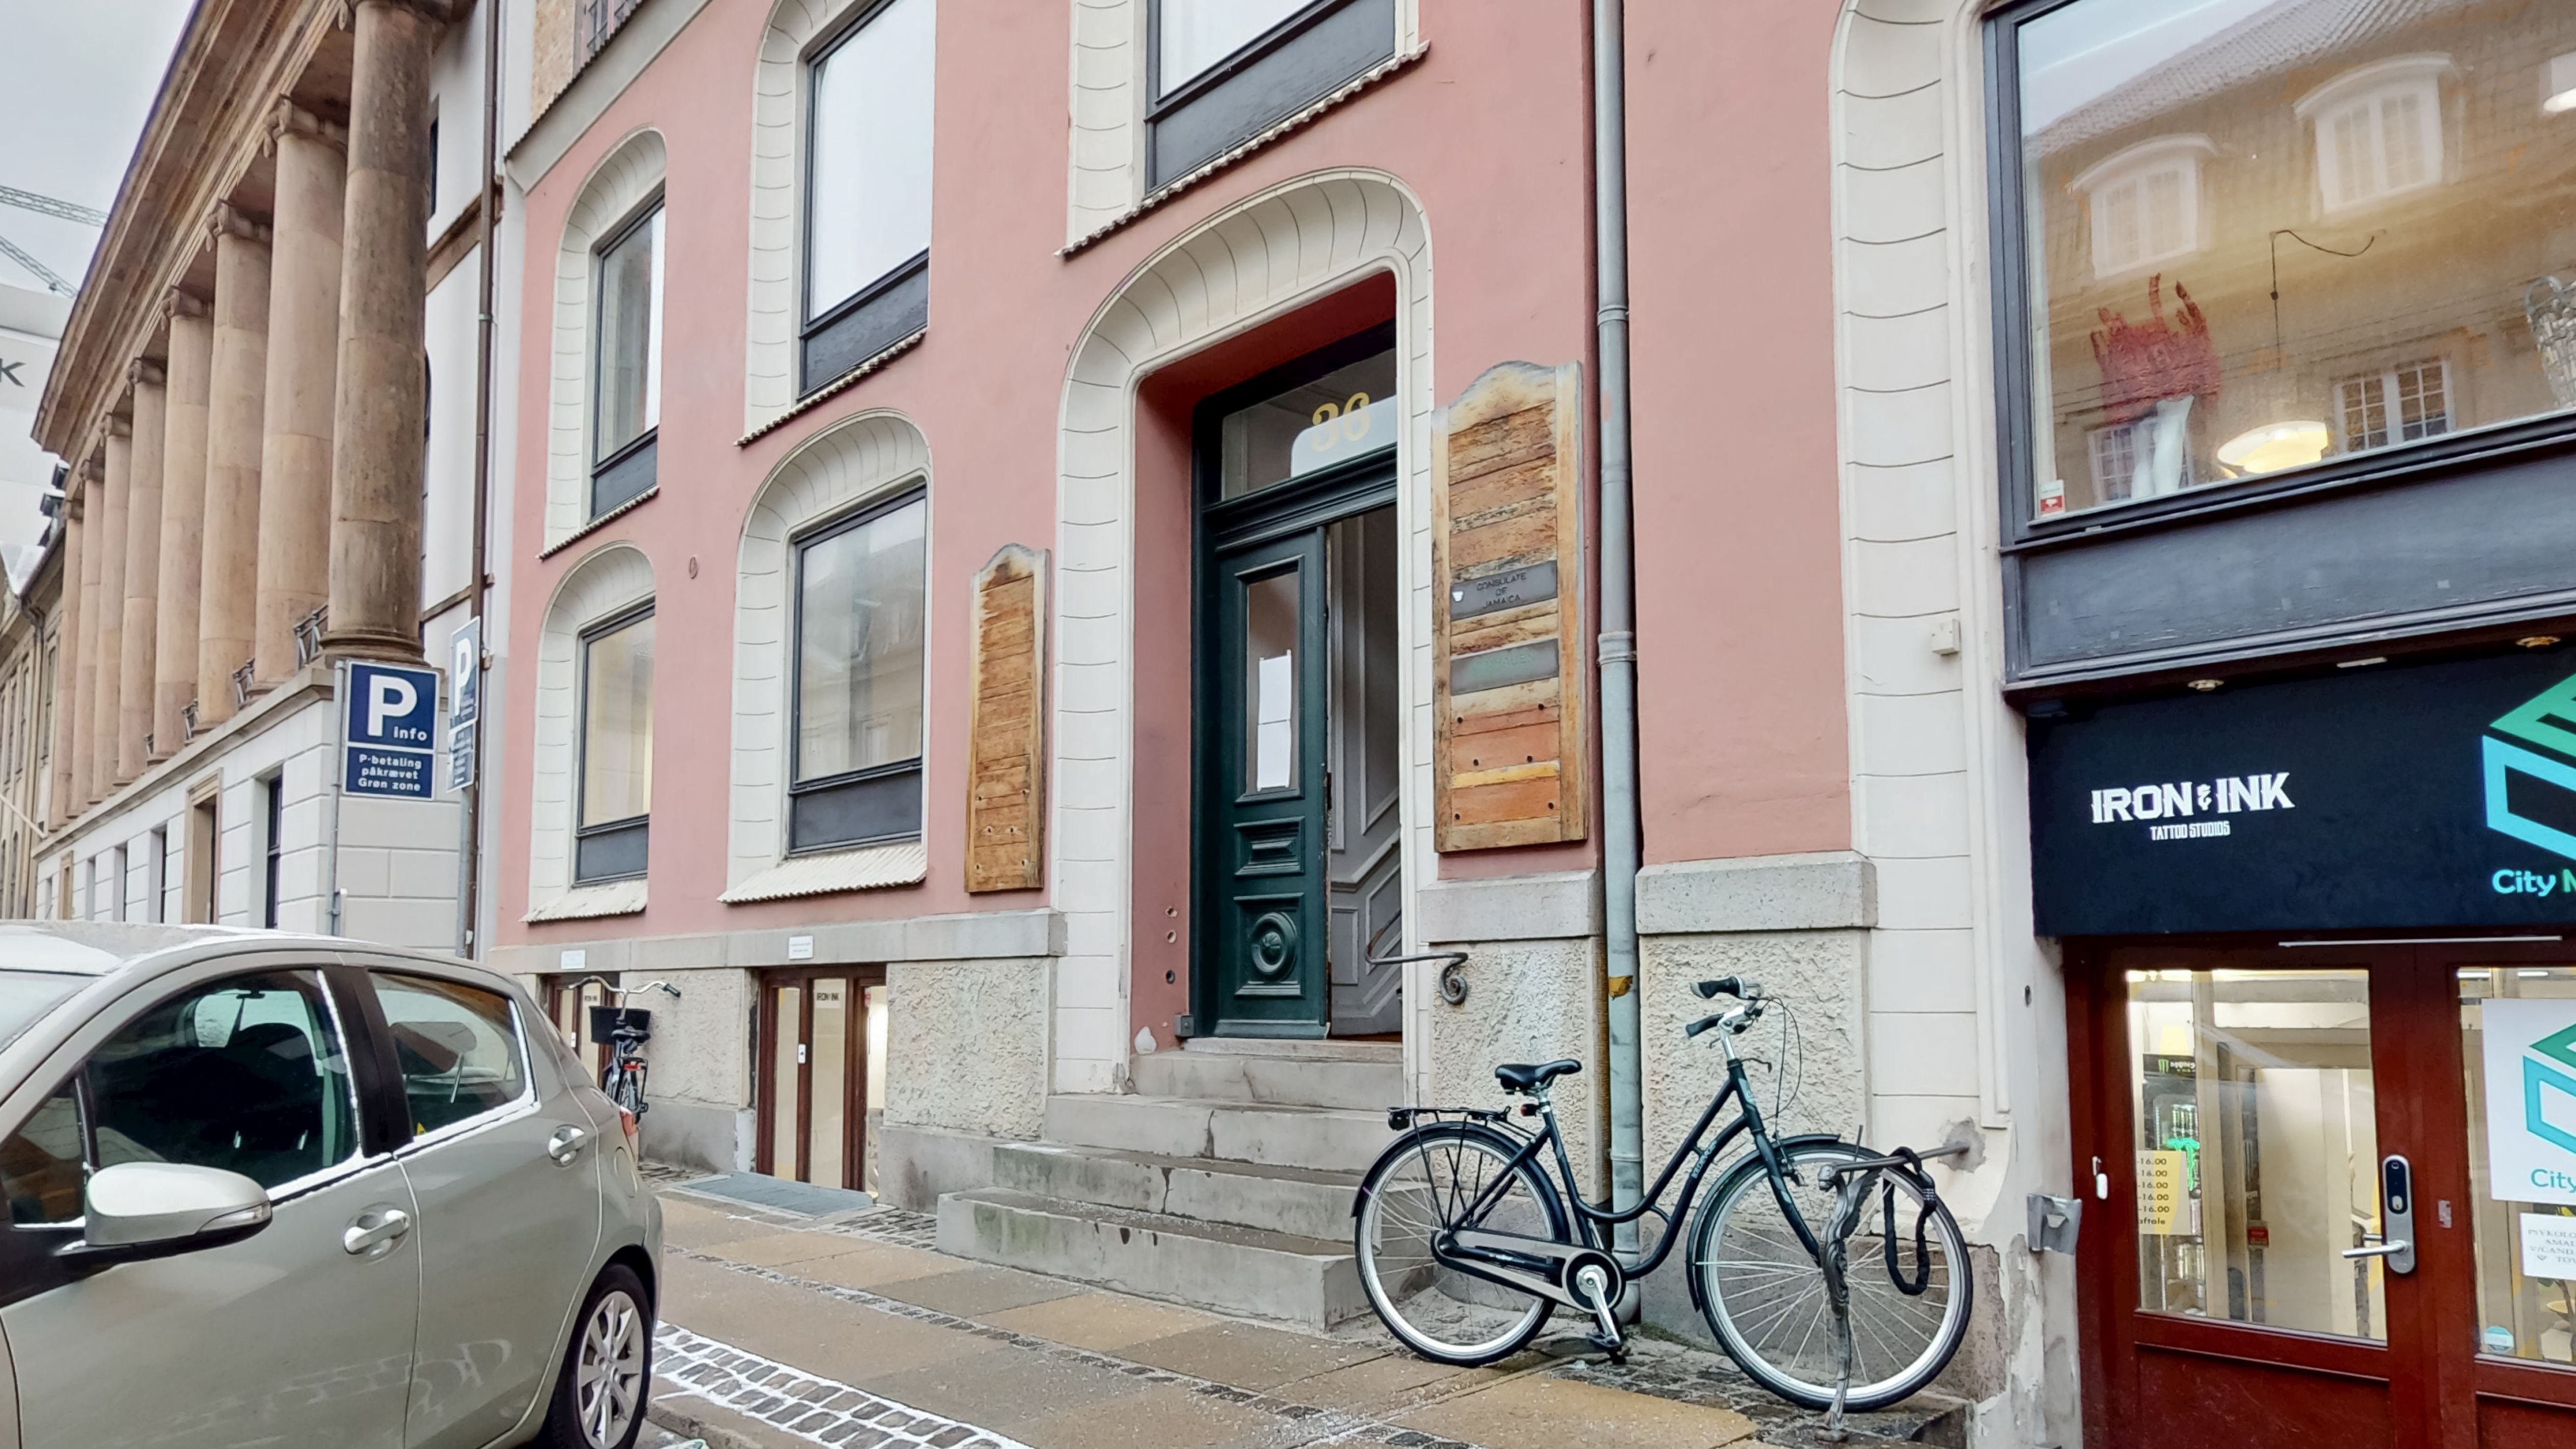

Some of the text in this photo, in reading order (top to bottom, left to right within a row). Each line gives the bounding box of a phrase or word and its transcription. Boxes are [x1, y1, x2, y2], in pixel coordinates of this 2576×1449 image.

[1476, 572, 1527, 591] CONSULATE
[1496, 587, 1507, 596] OF
[1483, 594, 1521, 609] JAMAICA
[367, 674, 418, 736] P
[393, 726, 427, 741] Info
[359, 754, 422, 770] P-betaling
[392, 782, 421, 791] zone
[2091, 781, 2194, 824] IRON
[2215, 772, 2295, 814] INK
[2150, 821, 2231, 841] TATTOO STUDIOS
[2492, 869, 2556, 897] City
[2531, 1168, 2576, 1193] City
